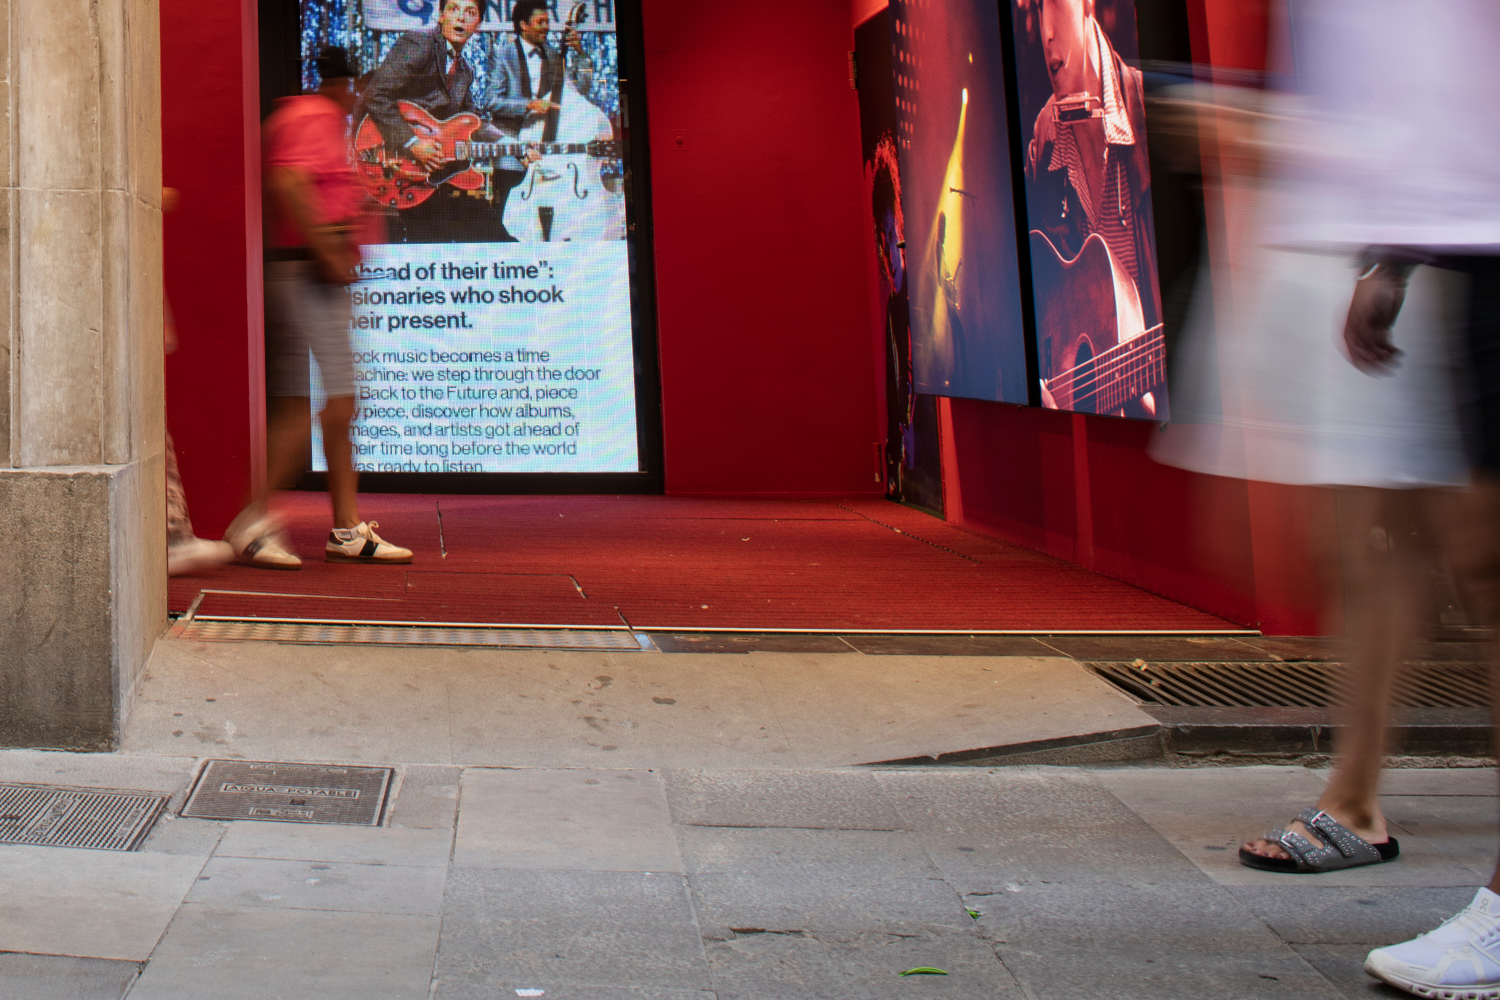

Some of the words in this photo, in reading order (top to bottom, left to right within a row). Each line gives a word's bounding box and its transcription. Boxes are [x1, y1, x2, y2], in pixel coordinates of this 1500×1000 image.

[415, 262, 436, 280] of
[441, 261, 488, 280] their
[450, 286, 495, 304] who
[499, 285, 564, 304] shook
[388, 311, 473, 332] present.
[353, 349, 379, 363] ock
[382, 349, 428, 363] music
[430, 348, 502, 363] becomes
[504, 351, 514, 362] a
[517, 348, 550, 363] time
[355, 368, 409, 381] achine:
[411, 370, 435, 381] we
[437, 367, 471, 383] step
[474, 366, 534, 383] through
[537, 366, 562, 380] the
[564, 366, 601, 380] door
[360, 386, 398, 400] Back
[401, 386, 417, 400] to
[420, 386, 444, 400] the
[446, 385, 497, 400] Future
[500, 385, 533, 401] and,
[536, 384, 578, 402] piece
[364, 404, 409, 420] piece,
[412, 403, 477, 418] discover
[479, 403, 513, 418] how
[515, 403, 575, 420] albums,
[349, 424, 401, 439] mages,
[403, 422, 432, 436] and
[435, 422, 482, 436] artists
[485, 422, 510, 439] got
[513, 422, 562, 436] ahead
[564, 421, 580, 436] of
[380, 441, 413, 455] time
[415, 441, 449, 458] long
[451, 441, 502, 455] before
[505, 441, 530, 455] the
[533, 441, 577, 455] world
[353, 462, 374, 472] as
[377, 459, 421, 472] ready
[423, 459, 440, 472] to
